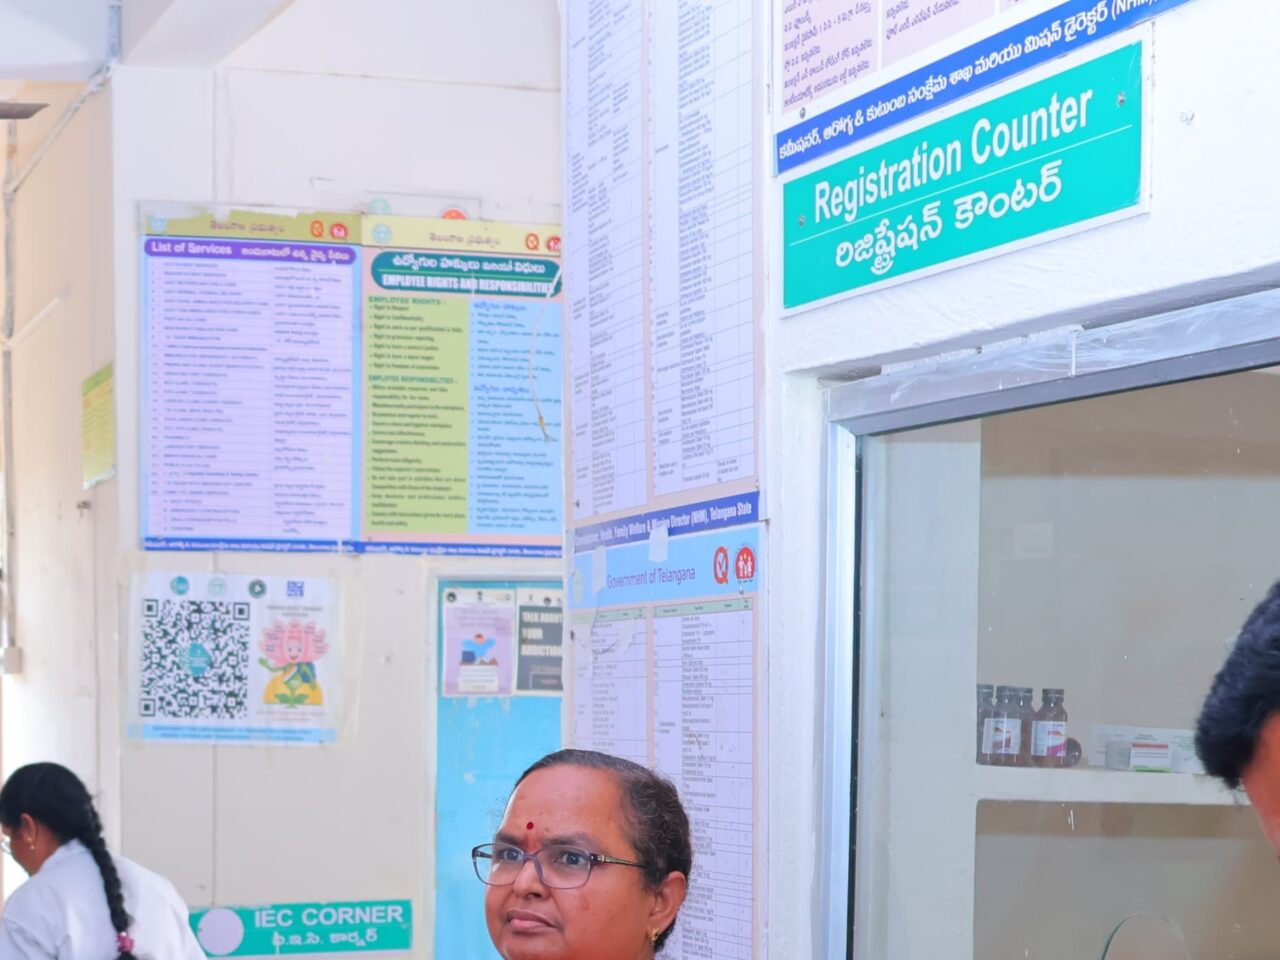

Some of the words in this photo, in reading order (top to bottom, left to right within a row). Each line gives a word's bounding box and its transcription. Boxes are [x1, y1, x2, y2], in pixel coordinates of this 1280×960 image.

[823, 112, 855, 140] ఆరోగ్య
[855, 108, 865, 126] &
[866, 95, 907, 123] కుటుంబ
[907, 76, 948, 106] సంక్షేమ
[949, 65, 974, 88] శాఖ
[974, 45, 1022, 75] మరియు
[1024, 21, 1063, 53] మిషన్
[1064, 1, 1109, 42] డైరెక్టర్
[815, 140, 962, 224] Registration
[970, 88, 1094, 165] Counter
[953, 159, 1063, 230] కౌంటర్
[152, 242, 173, 253] List
[175, 242, 187, 253] of
[188, 243, 233, 256] Services
[382, 273, 427, 288] EMPLOYEE
[427, 276, 460, 289] RIGHTS
[460, 277, 478, 290] AND
[710, 506, 737, 521] Telangana
[737, 501, 752, 516] State
[607, 573, 648, 589] Government
[649, 570, 657, 582] of
[658, 567, 696, 586] Telangana
[522, 611, 539, 623] TALK
[522, 627, 543, 640] YOUR
[254, 909, 293, 928] IEC
[301, 905, 404, 927] CORNER
